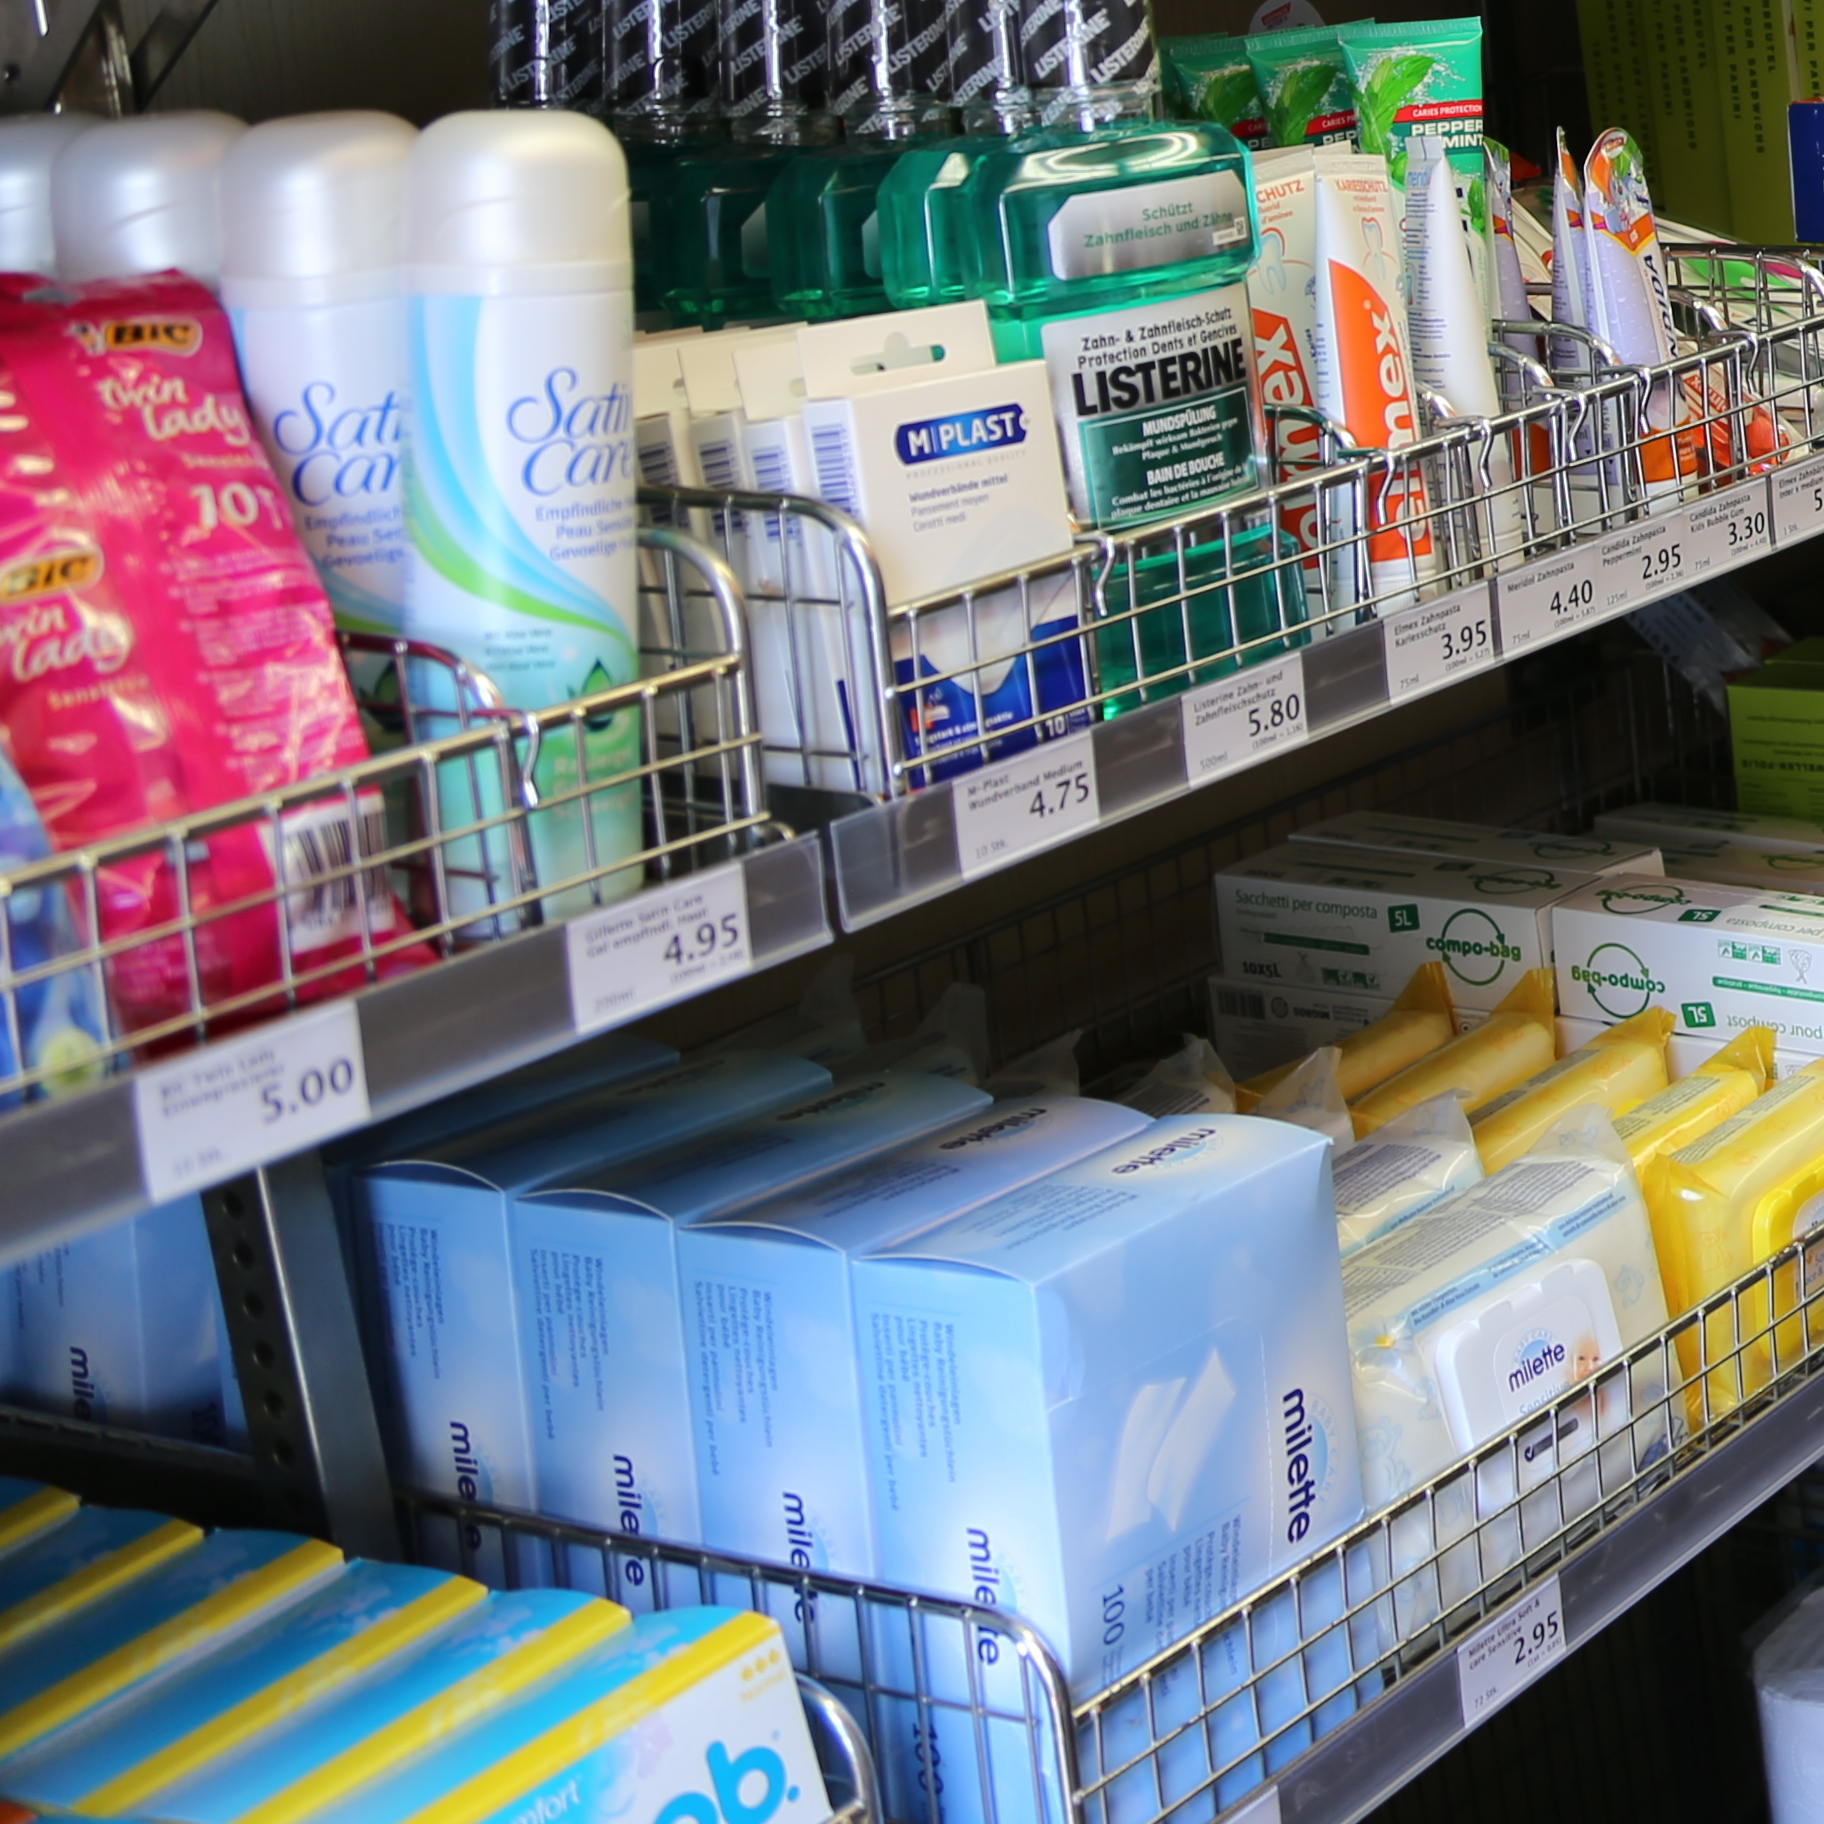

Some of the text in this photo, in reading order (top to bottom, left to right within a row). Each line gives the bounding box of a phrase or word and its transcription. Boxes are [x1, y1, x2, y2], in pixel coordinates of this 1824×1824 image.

[1411, 119, 1484, 136] PEPPER
[1443, 134, 1484, 149] MINT
[111, 325, 191, 346] BIC
[1077, 323, 1237, 370] Protection Dents et Gencives
[1081, 307, 1233, 353] Zahn- & Zahnfleisch-Schutz
[1071, 338, 1247, 416] LISTERINE
[1142, 405, 1216, 437] MUNDSPÜLUNG
[1146, 452, 1225, 486] BAIN DE BOUCHE
[908, 473, 1008, 503] Wundverbände mittel
[1111, 476, 1200, 506] Combat les bactéries
[1601, 524, 1666, 556] Candida Zahnpasta
[1727, 511, 1765, 546] 3.30
[1602, 546, 1642, 568] Peppermint
[1641, 543, 1681, 581] 2.95
[1507, 561, 1575, 594] Meridol Zahnpasta
[1549, 579, 1593, 616] 4.40
[1394, 603, 1461, 636] Elmex Zahnpasta
[1395, 620, 1447, 648] Kariesschutz
[1440, 618, 1487, 661] 3.95
[1246, 692, 1302, 740] 5.80
[1029, 772, 1090, 820] 4.75
[1235, 889, 1378, 920] Sacchetti per composta
[1394, 910, 1412, 926] 5L
[660, 911, 741, 971] 4.95
[1425, 935, 1522, 962] compo-bag
[1242, 960, 1282, 978] 10X5L
[1571, 964, 1666, 994] compo-bag
[1687, 1005, 1708, 1024] 5L
[259, 1055, 356, 1127] 5.00
[1110, 1126, 1218, 1176] milette
[1507, 1340, 1567, 1394] milette
[1283, 1388, 1316, 1544] milette
[1512, 1611, 1559, 1667] 2.95
